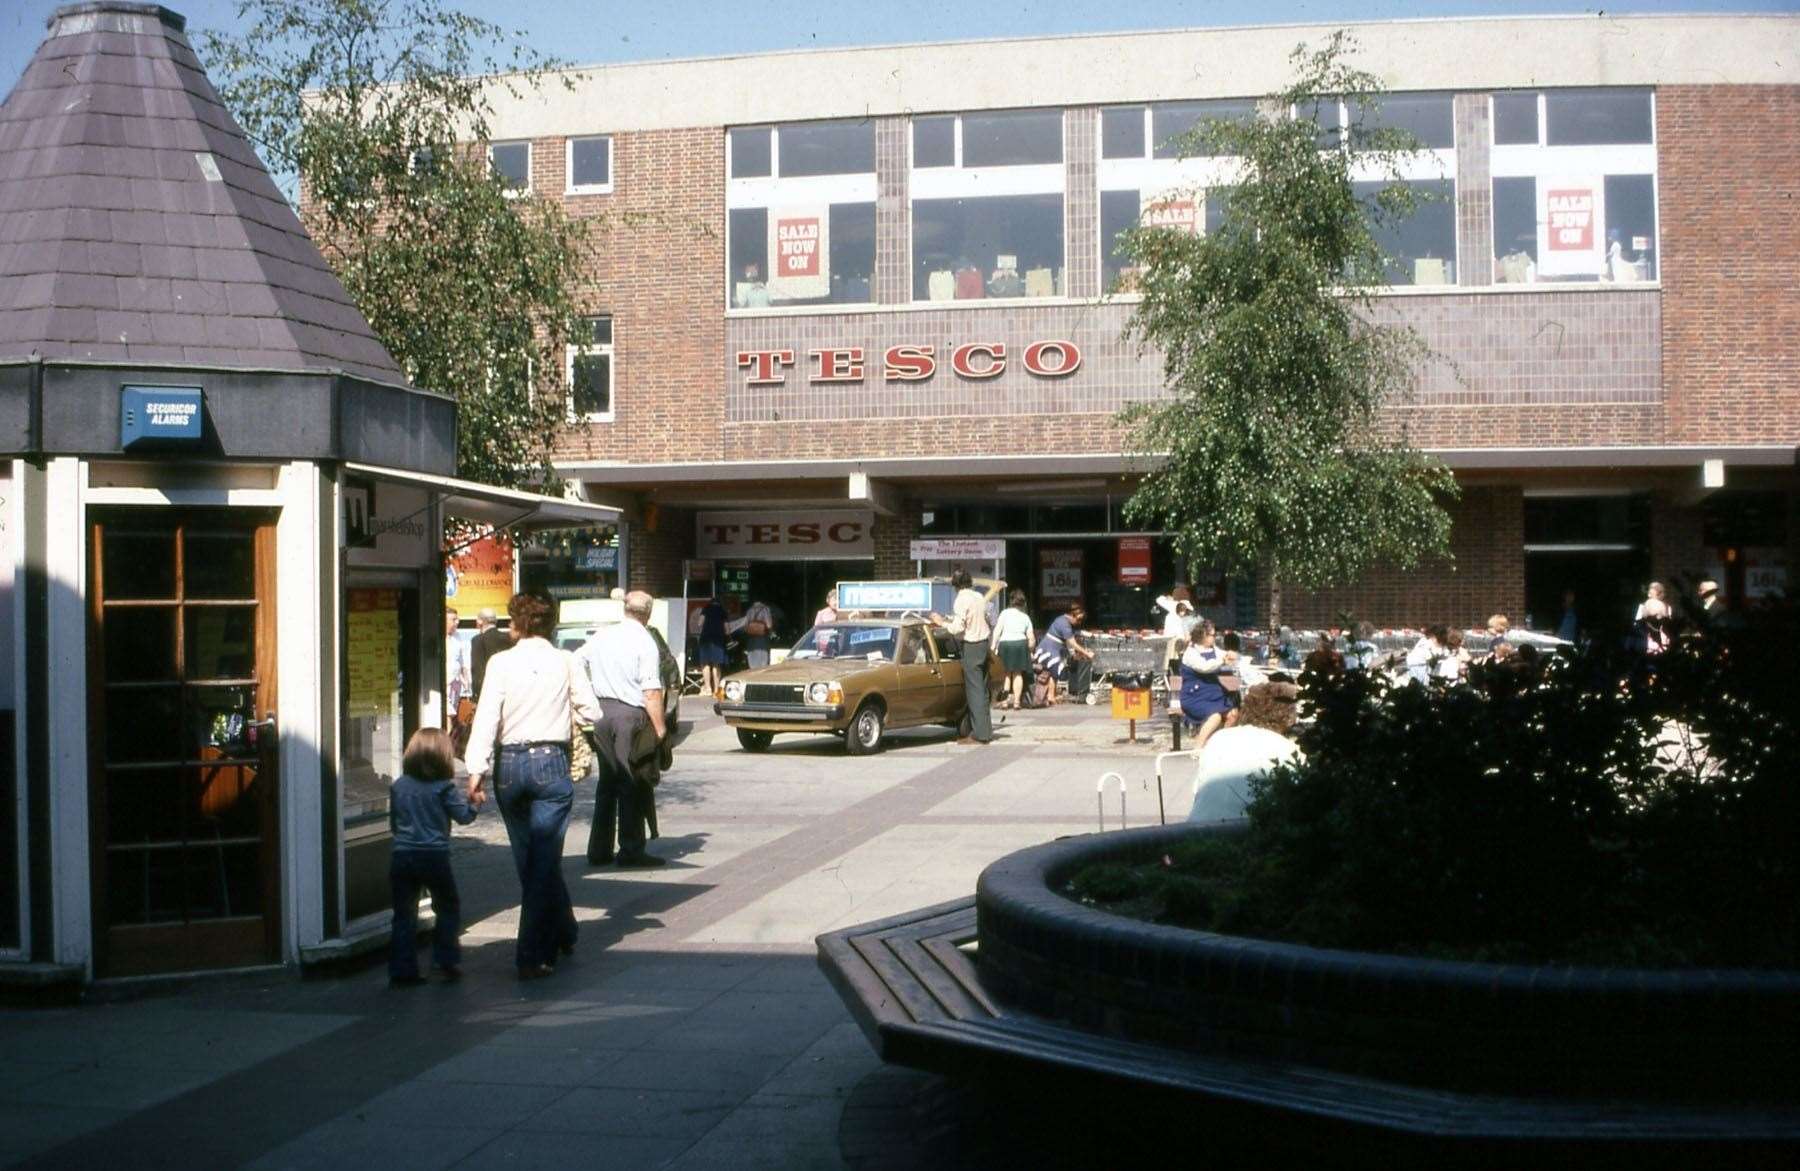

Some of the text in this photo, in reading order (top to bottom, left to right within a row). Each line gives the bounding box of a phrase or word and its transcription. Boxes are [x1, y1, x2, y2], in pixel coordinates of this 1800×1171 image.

[1549, 196, 1591, 212] SALE
[1151, 208, 1193, 225] SALE
[1551, 212, 1590, 228] NOW
[779, 225, 818, 240] SALE
[1559, 228, 1582, 244] ON
[781, 240, 816, 255] NOW
[788, 255, 809, 270] ON
[736, 340, 1081, 384] TESCO
[146, 403, 197, 414] SECURICOR
[151, 415, 190, 426] ALARMS
[704, 521, 875, 545] TESC
[586, 558, 615, 568] SPECIAL
